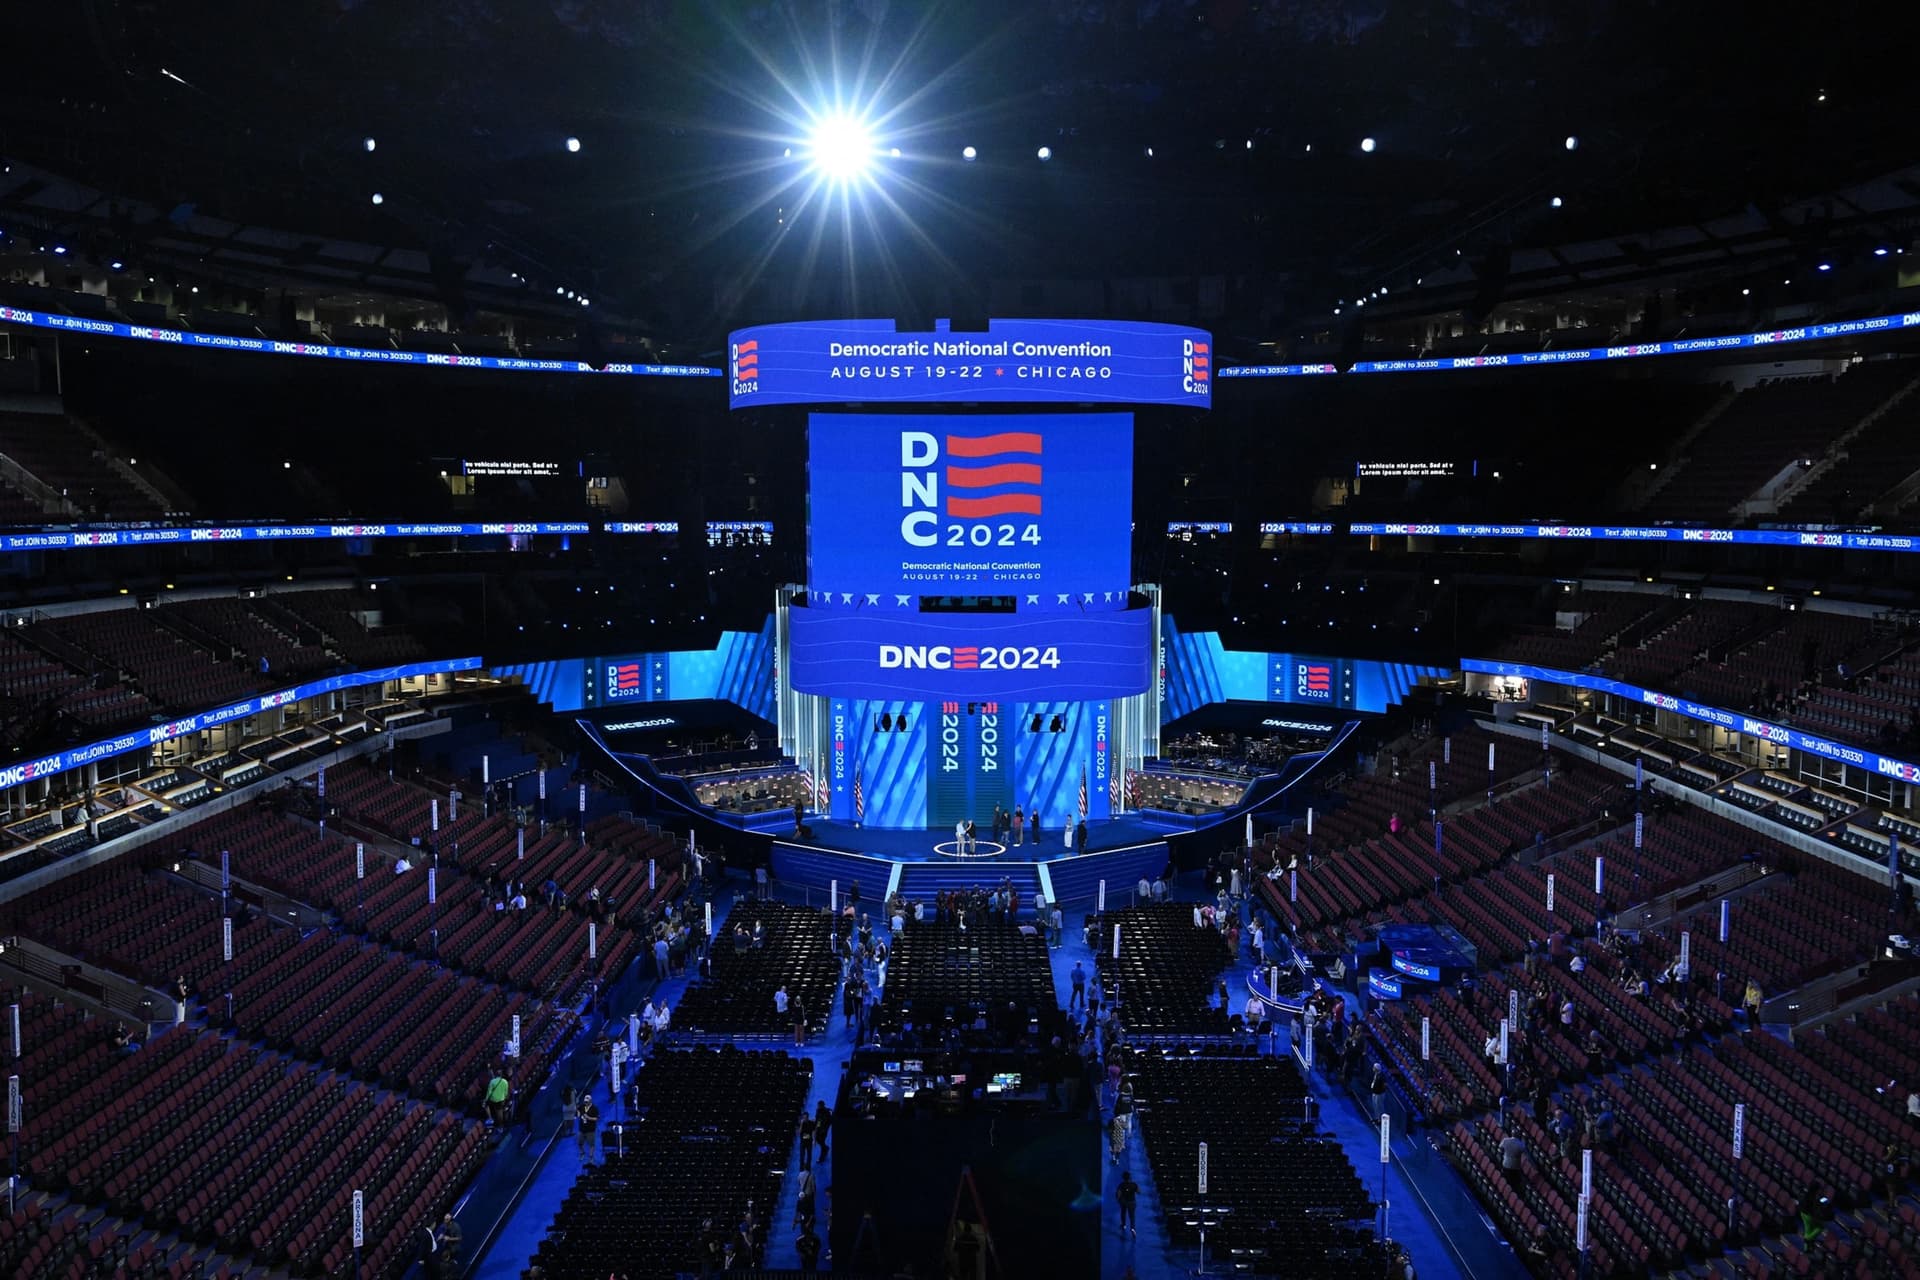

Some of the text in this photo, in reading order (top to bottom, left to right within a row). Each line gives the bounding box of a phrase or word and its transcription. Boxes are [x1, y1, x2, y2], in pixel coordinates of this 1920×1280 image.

[65, 318, 82, 328] JOIN
[1838, 323, 1856, 332] JOIN
[211, 336, 230, 345] JOIN
[1689, 340, 1707, 349] JOIN
[830, 340, 1111, 357] Democratic National Convention
[831, 366, 1112, 379] AUGUST 19-22 CHICAGO
[738, 380, 758, 394] 2024
[1193, 382, 1208, 395] 2024
[25, 536, 40, 545] JOIN
[947, 524, 1042, 547] 2024
[1868, 537, 1884, 546] JOIN
[902, 561, 1041, 570] Democratic National Convention
[618, 688, 640, 697] 2024
[1308, 690, 1329, 698] 2024
[942, 714, 959, 772] 2024
[981, 714, 997, 772] 2024
[1816, 742, 1832, 753] JOIN
[89, 745, 105, 756] JOIN
